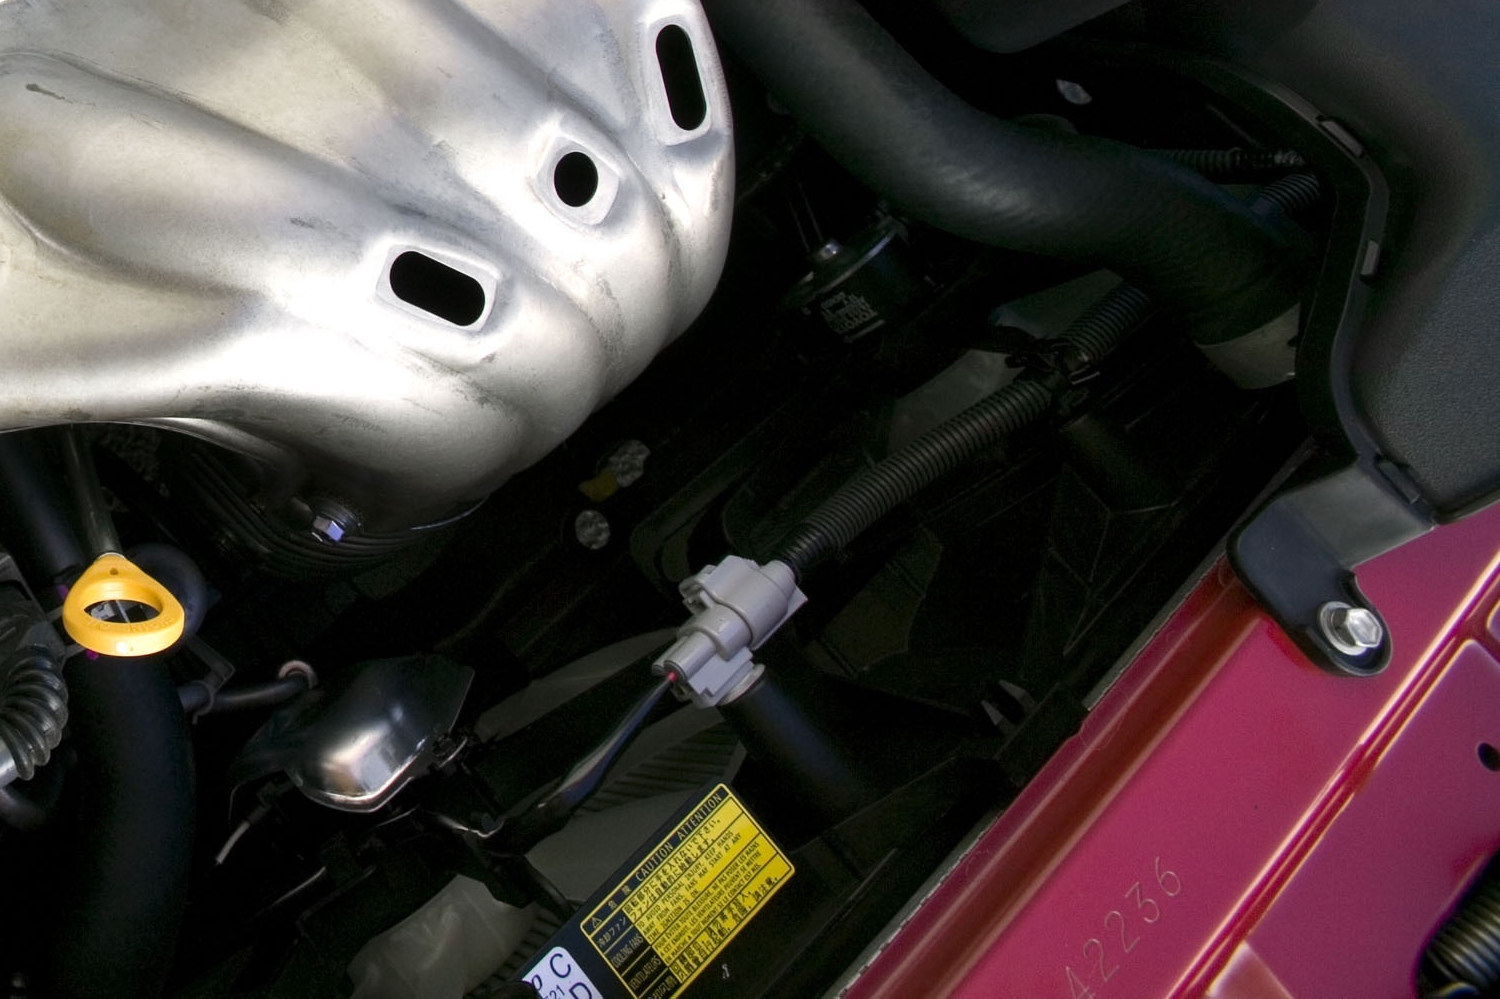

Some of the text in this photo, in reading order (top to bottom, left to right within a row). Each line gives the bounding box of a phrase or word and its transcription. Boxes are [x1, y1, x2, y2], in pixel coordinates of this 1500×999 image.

[634, 791, 723, 882] CAUTION ATTENTION
[636, 919, 645, 930] TO
[644, 902, 661, 921] AVOID
[660, 879, 685, 905] PERSONAL
[703, 846, 717, 861] KEEP
[715, 829, 734, 848] HANDS
[641, 920, 656, 936] AWAY
[655, 905, 670, 921] FROM
[684, 877, 698, 892] FANS
[696, 865, 709, 879] MAY
[708, 851, 724, 867] START
[722, 843, 731, 853] AT
[730, 831, 742, 845] ANY
[646, 927, 661, 943] TIME
[659, 904, 683, 929] IGNITION
[1065, 855, 1180, 999] 42236
[549, 953, 571, 978] C
[627, 931, 645, 951] FANS
